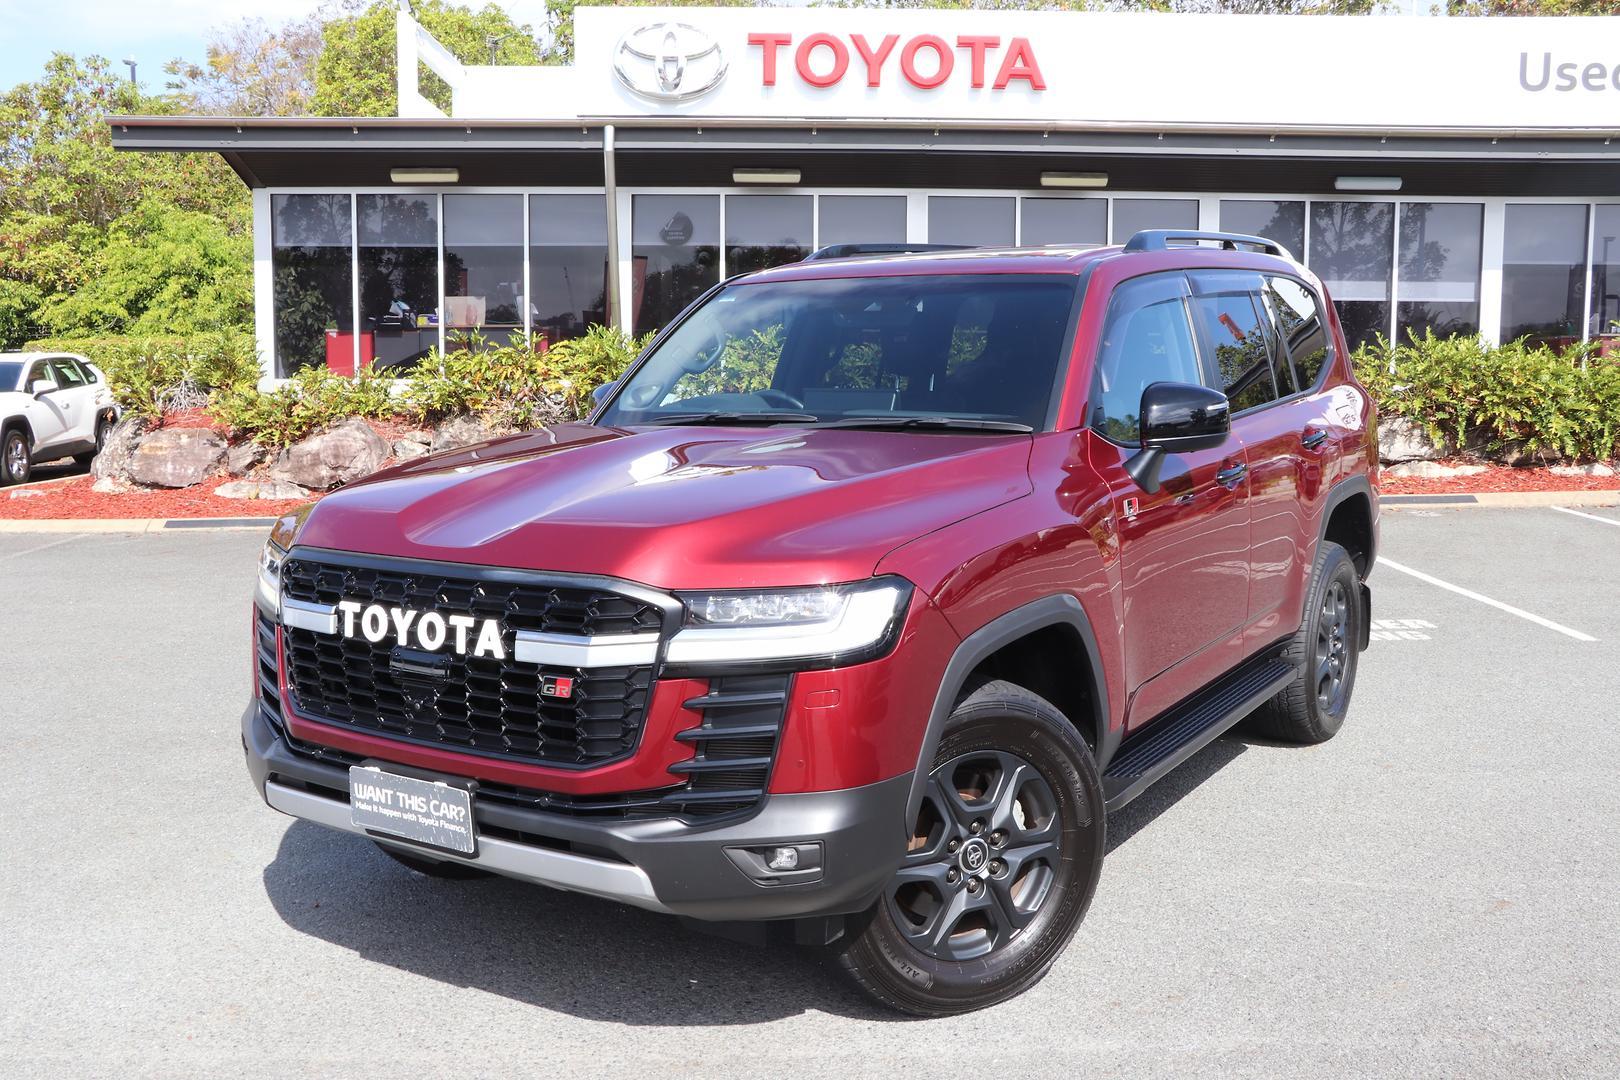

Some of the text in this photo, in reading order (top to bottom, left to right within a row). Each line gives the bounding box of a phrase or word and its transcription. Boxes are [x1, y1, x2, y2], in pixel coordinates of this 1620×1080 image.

[747, 32, 1047, 90] TOYOTA
[1520, 52, 1620, 92] Use
[338, 601, 506, 659] TOYOTA
[543, 683, 570, 697] GR
[353, 783, 465, 822] WANT THIS CAR?
[355, 801, 372, 812] Make
[373, 804, 378, 813] it
[379, 806, 402, 817] happen
[402, 811, 417, 821] with
[418, 814, 439, 827] Toyota
